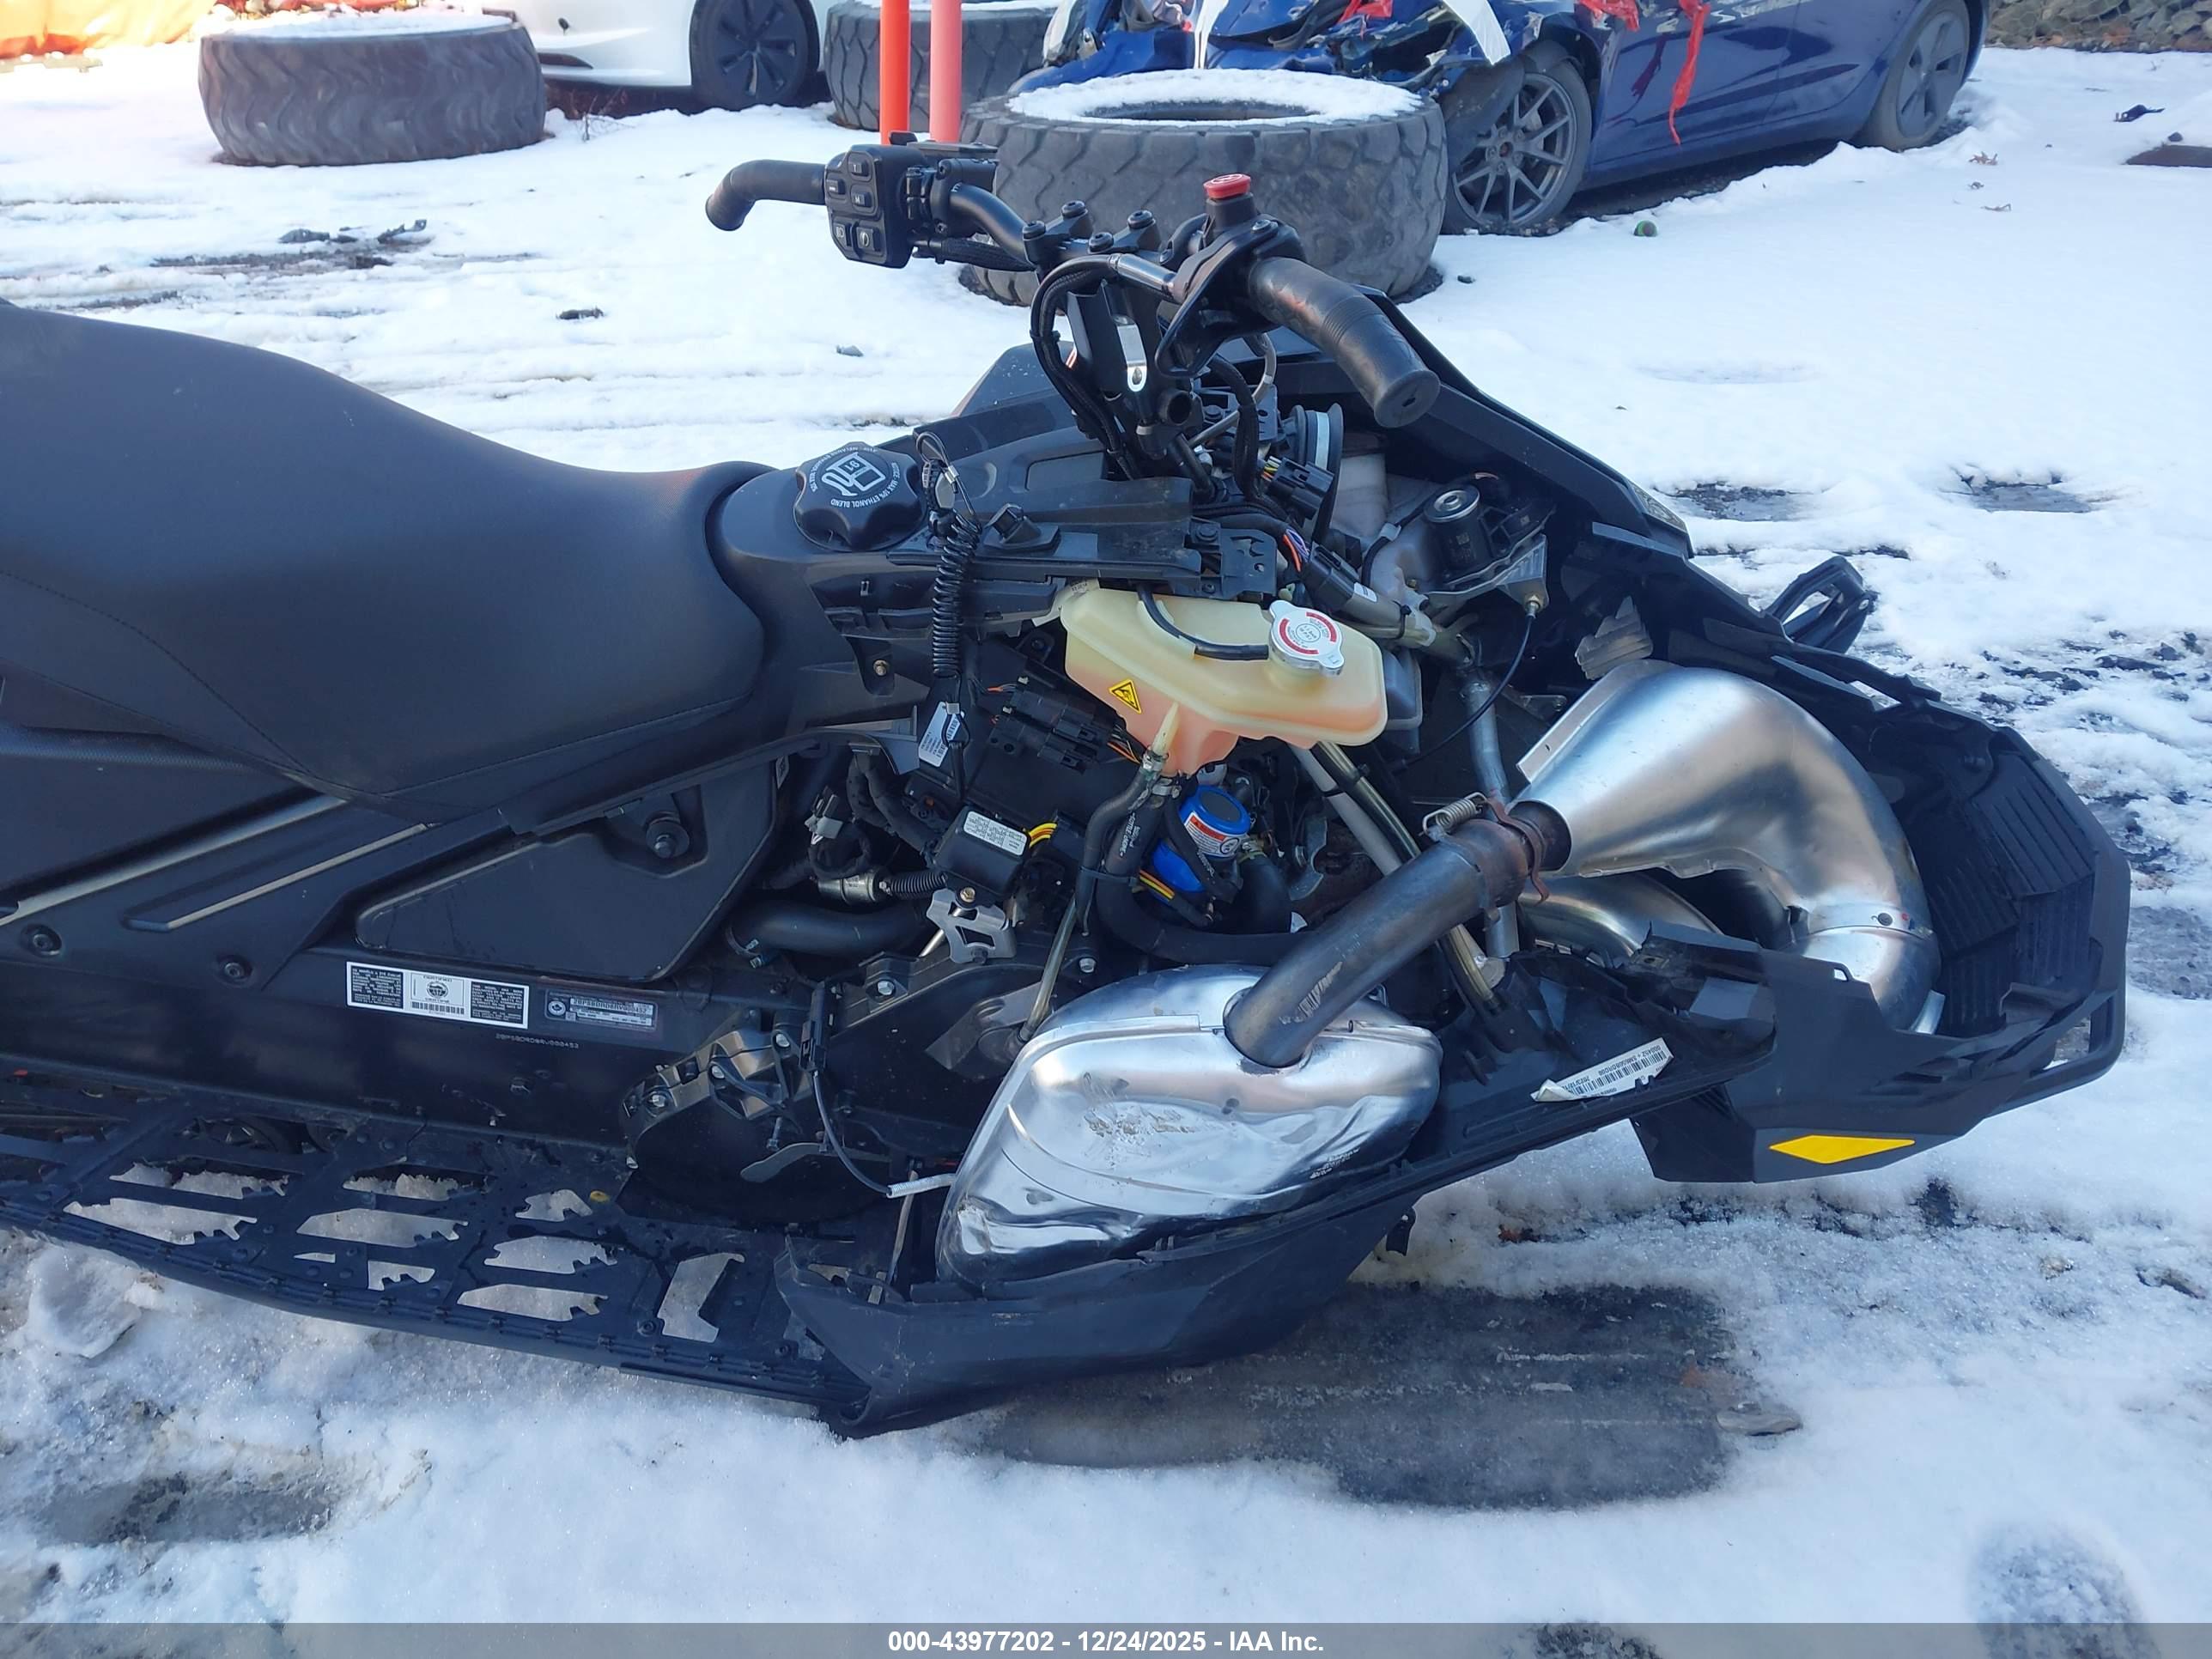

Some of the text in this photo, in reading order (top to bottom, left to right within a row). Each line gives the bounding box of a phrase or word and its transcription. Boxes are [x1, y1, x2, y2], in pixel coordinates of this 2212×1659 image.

[844, 460, 860, 471] 91
[830, 498, 850, 508] BLEND
[852, 495, 880, 508] ETHANOL
